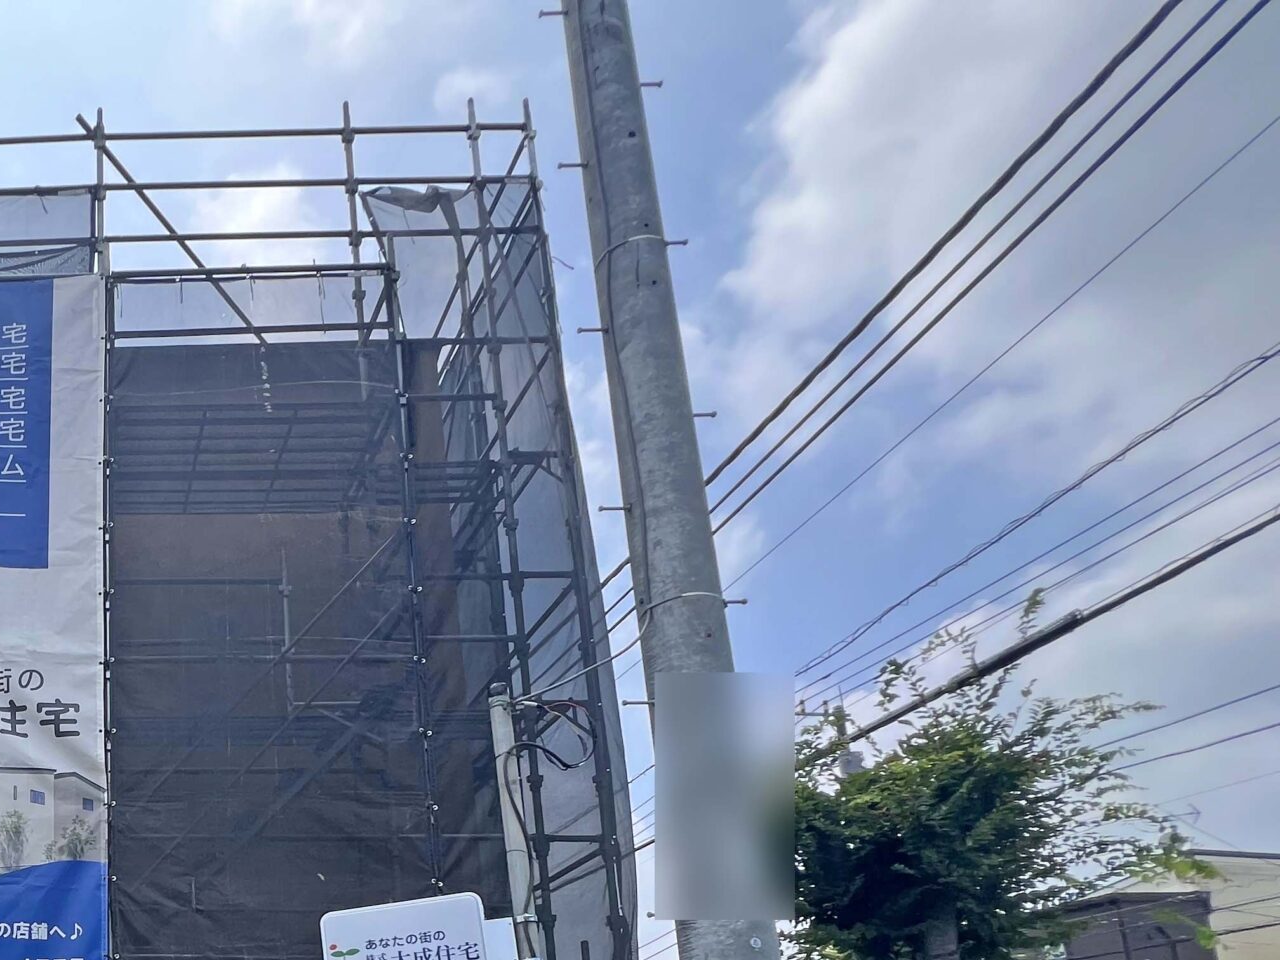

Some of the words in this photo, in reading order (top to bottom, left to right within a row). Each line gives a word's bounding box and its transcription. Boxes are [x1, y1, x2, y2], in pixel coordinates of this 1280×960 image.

[365, 930, 446, 950] あなたの街の
